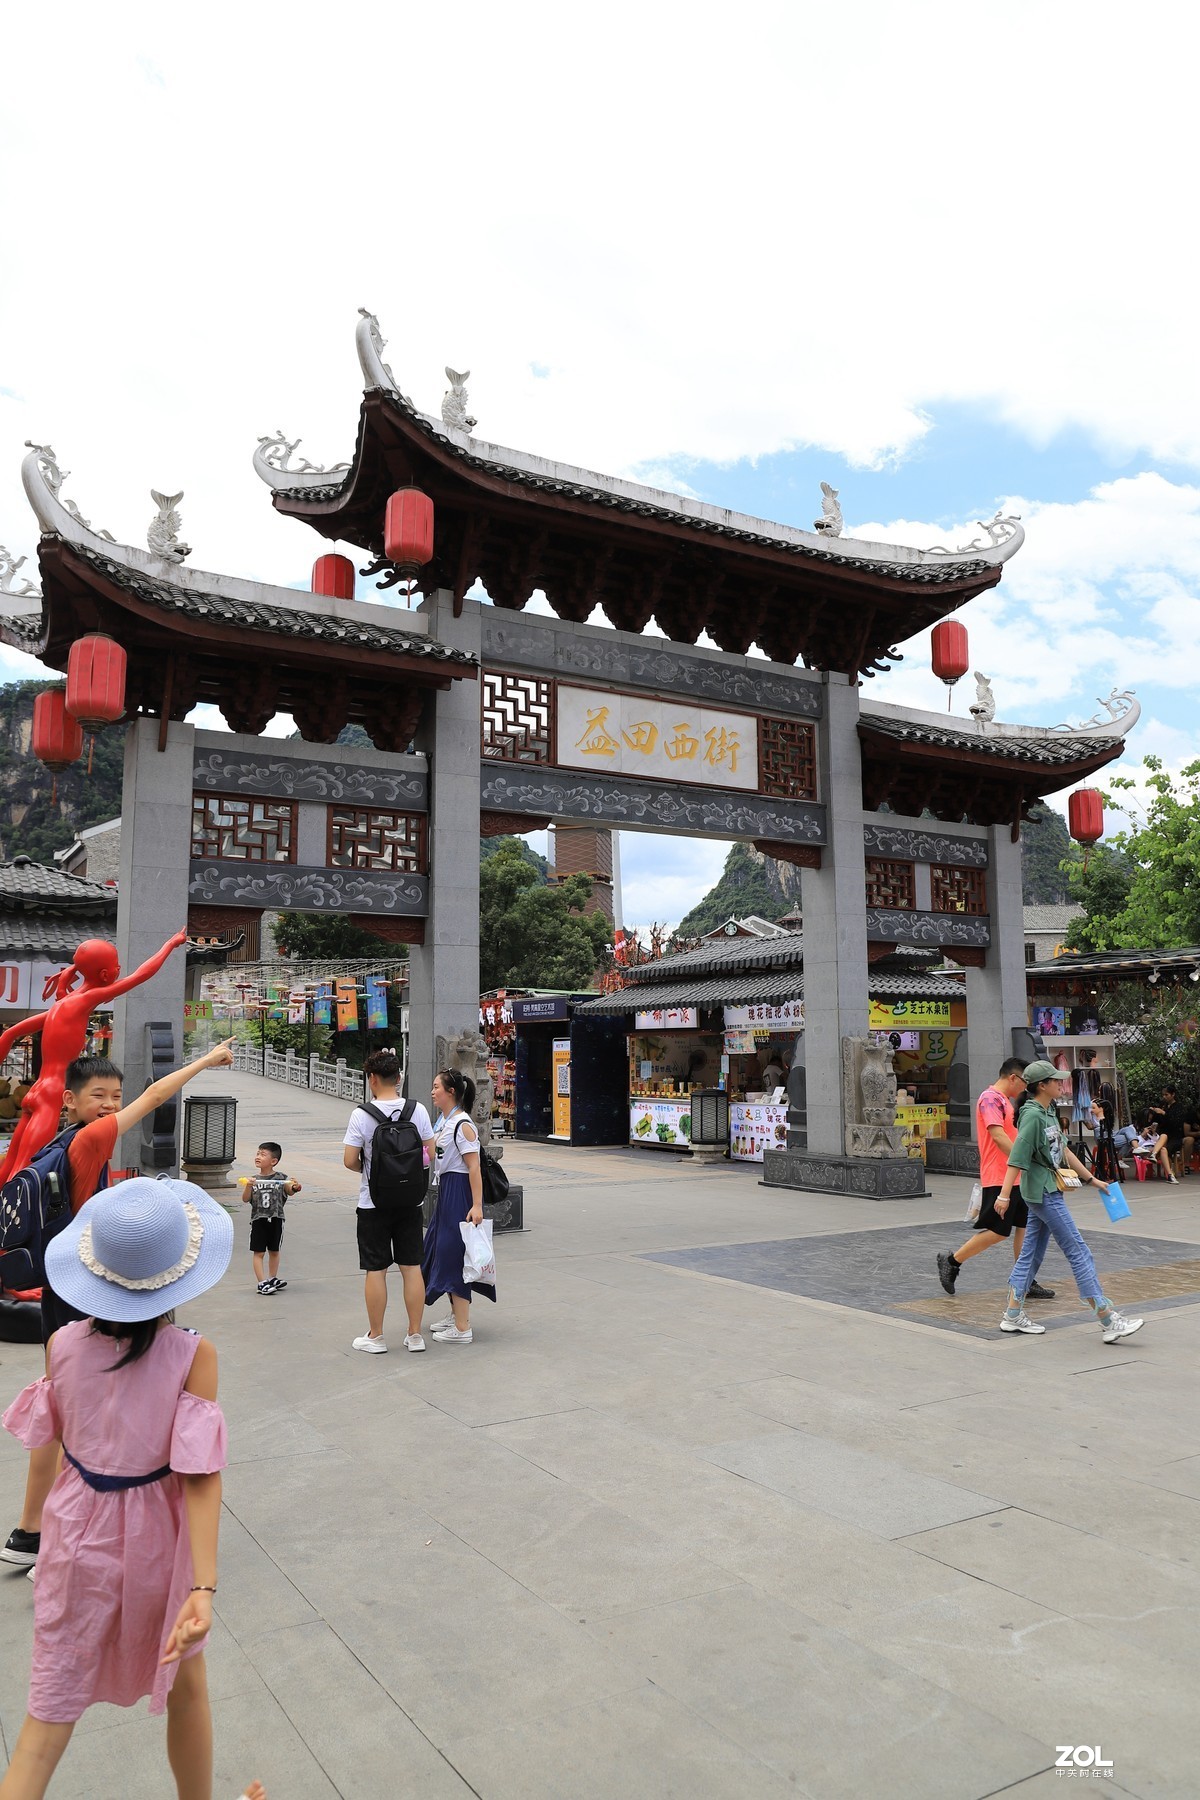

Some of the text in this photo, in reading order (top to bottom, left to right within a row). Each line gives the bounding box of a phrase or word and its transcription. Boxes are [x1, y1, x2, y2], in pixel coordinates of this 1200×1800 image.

[575, 706, 741, 773] 益田西街
[910, 1004, 949, 1016] 芝士水果饼
[262, 1193, 270, 1209] 8
